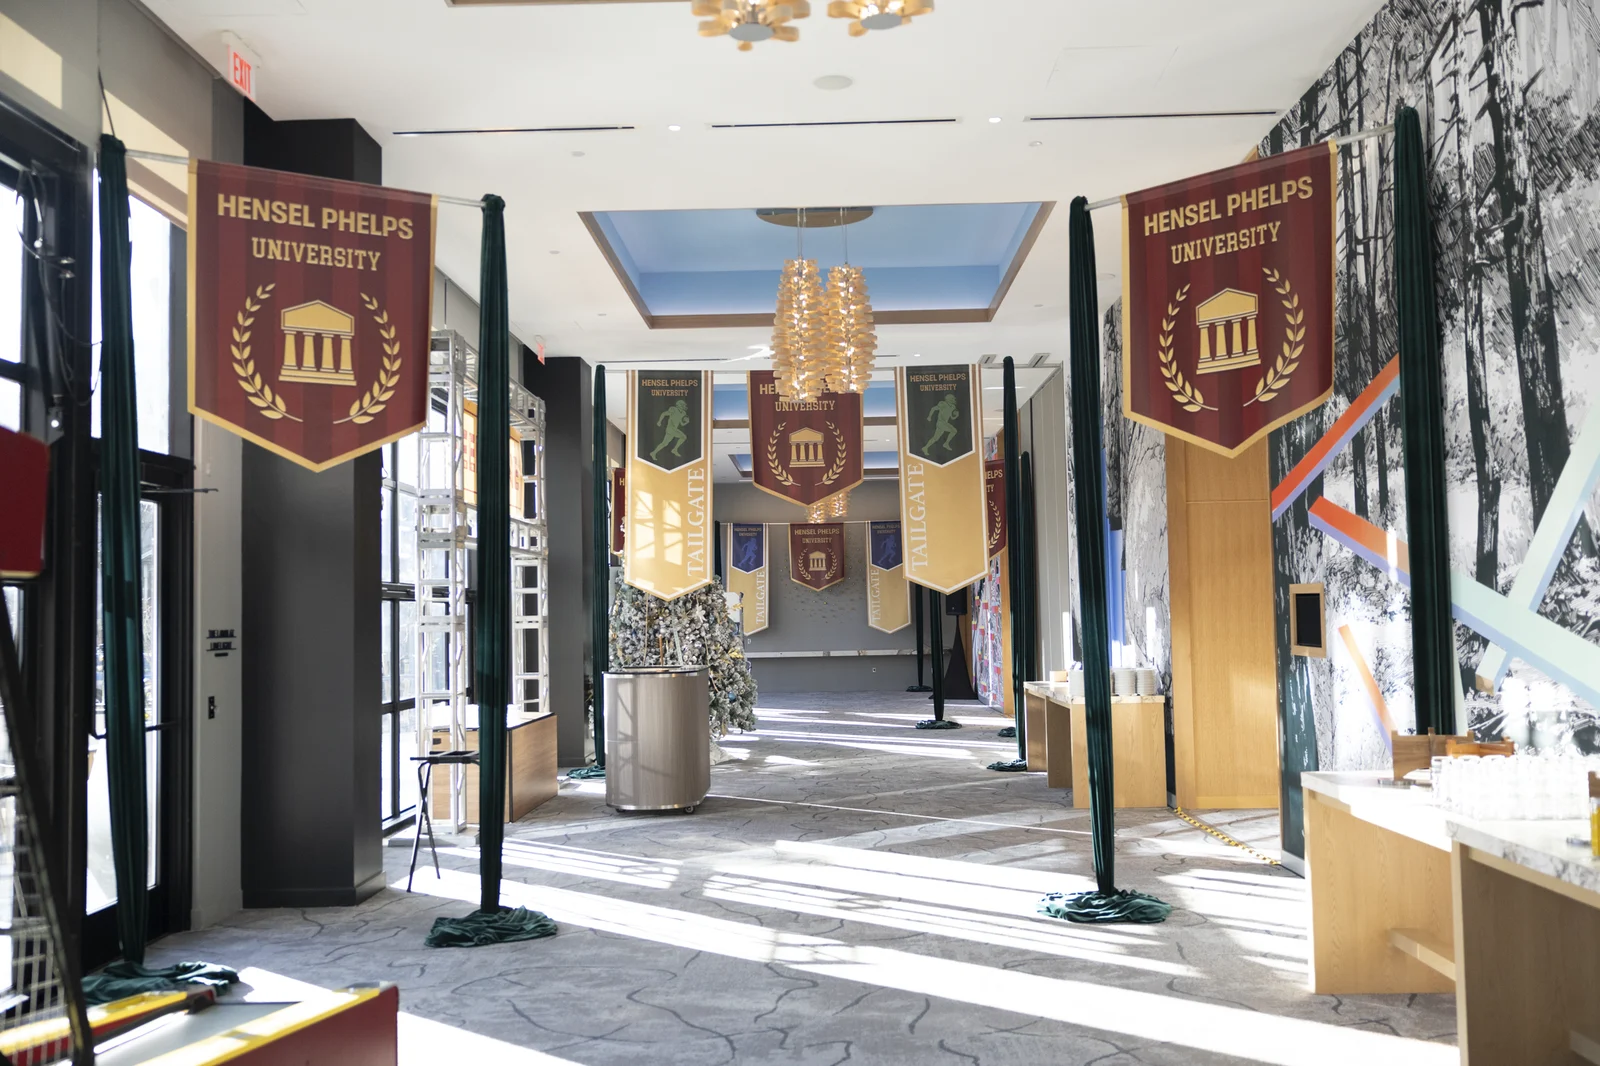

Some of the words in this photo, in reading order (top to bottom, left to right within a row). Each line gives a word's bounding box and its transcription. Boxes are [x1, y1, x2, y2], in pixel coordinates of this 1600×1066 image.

[233, 51, 252, 94] EXIT
[217, 193, 316, 228] HENSEL
[321, 207, 414, 240] PHELPS
[1144, 199, 1222, 237] HENSEL
[1227, 176, 1313, 217] PHELPS
[251, 237, 381, 271] UNIVERSITY
[1171, 221, 1281, 265] UNIVERSITY
[641, 379, 669, 387] HENSEL
[670, 379, 699, 387] PHELPS
[910, 374, 938, 382] HENSEL
[938, 373, 967, 381] PHELPS
[775, 401, 836, 411] UNIVERSITY
[986, 469, 1003, 479] ELPS
[687, 468, 705, 577] TAILGATE
[907, 463, 928, 572] TAILGATE
[755, 571, 766, 624] TAILGATE
[870, 569, 881, 623] TAILGATE
